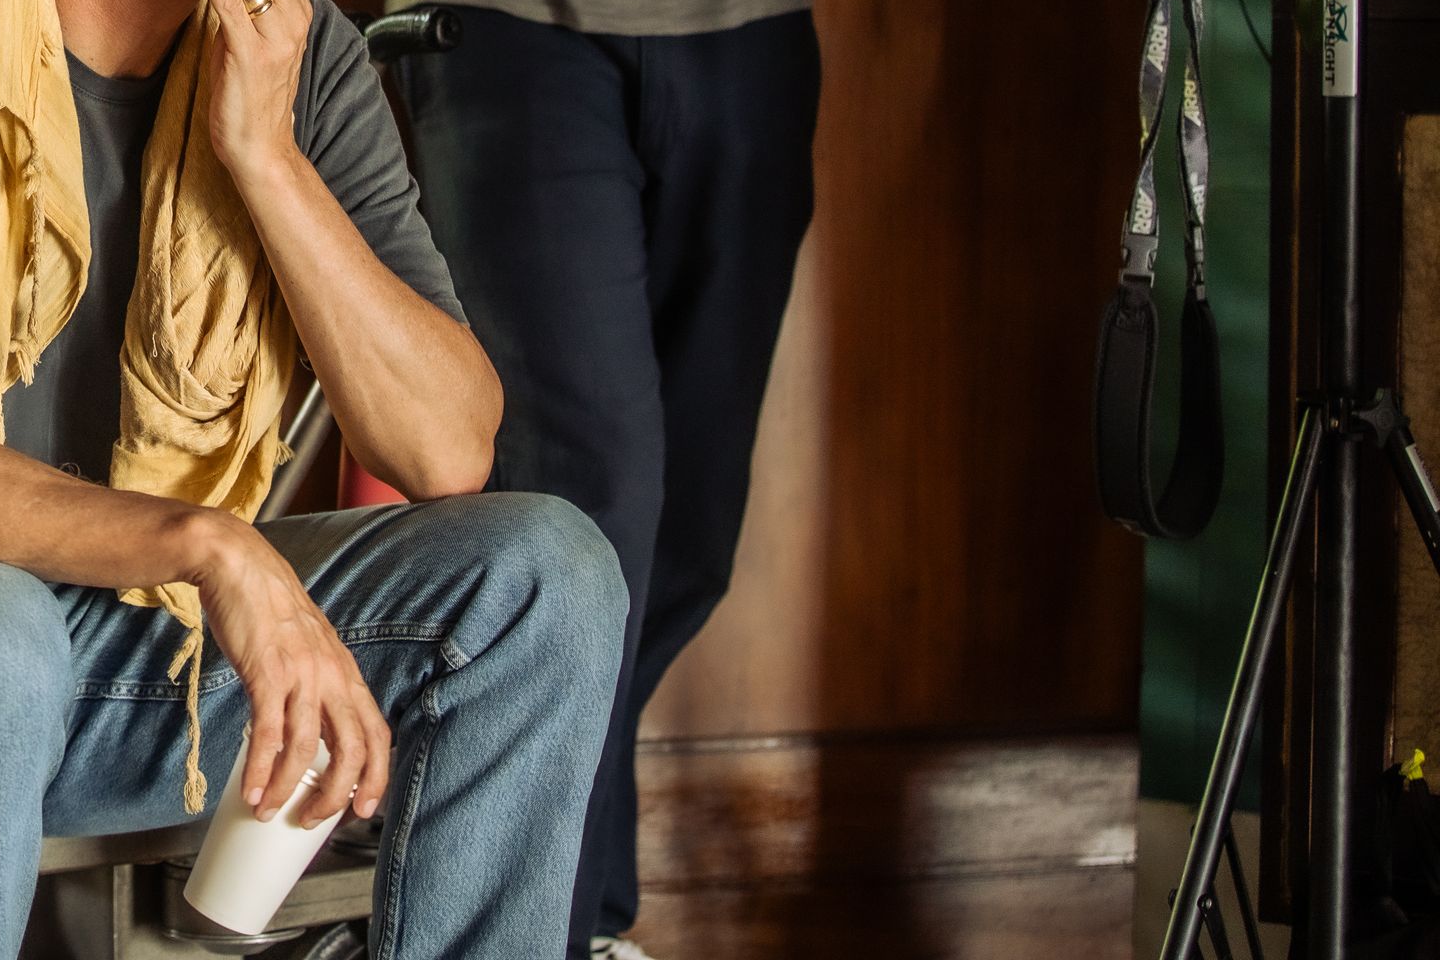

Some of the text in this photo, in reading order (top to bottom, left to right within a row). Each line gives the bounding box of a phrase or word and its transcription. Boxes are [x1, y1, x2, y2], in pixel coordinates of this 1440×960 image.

[1146, 24, 1169, 73] ARRI
[1183, 79, 1202, 127] ARRI
[1132, 187, 1153, 234] ARR
